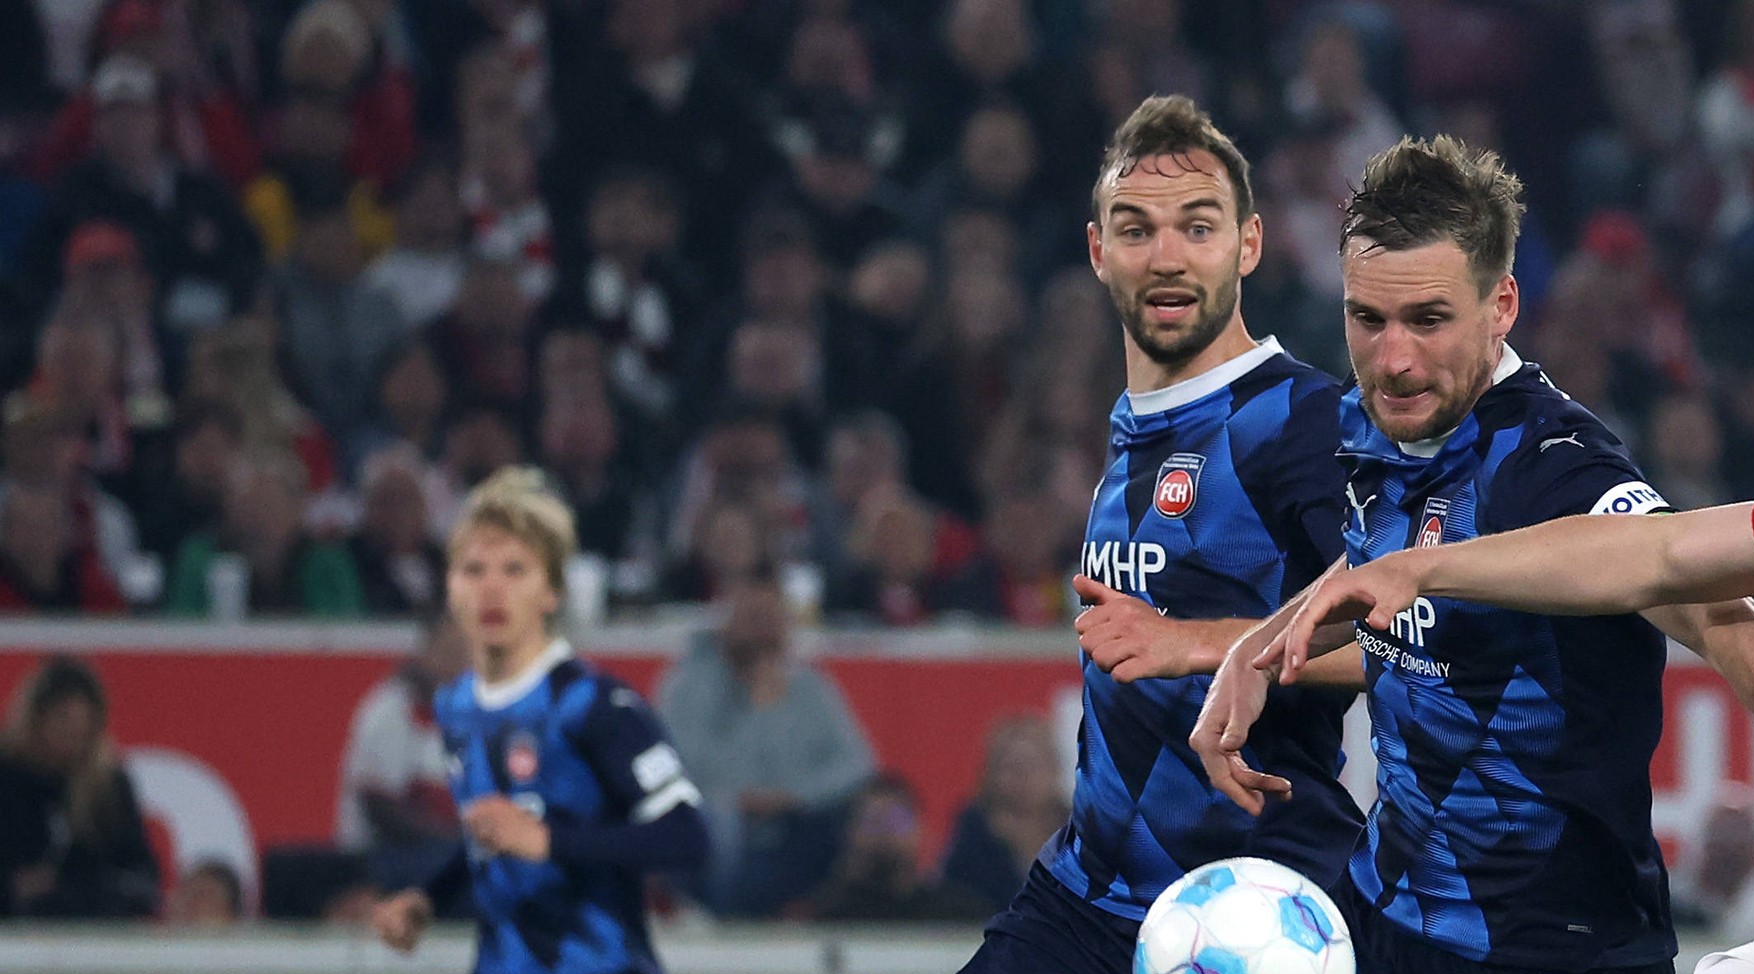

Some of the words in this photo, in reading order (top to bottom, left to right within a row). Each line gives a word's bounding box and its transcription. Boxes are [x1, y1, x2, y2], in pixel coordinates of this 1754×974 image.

[1160, 482, 1187, 503] FCH
[1355, 628, 1401, 664] PORSCHE
[1400, 651, 1450, 678] COMPANY
